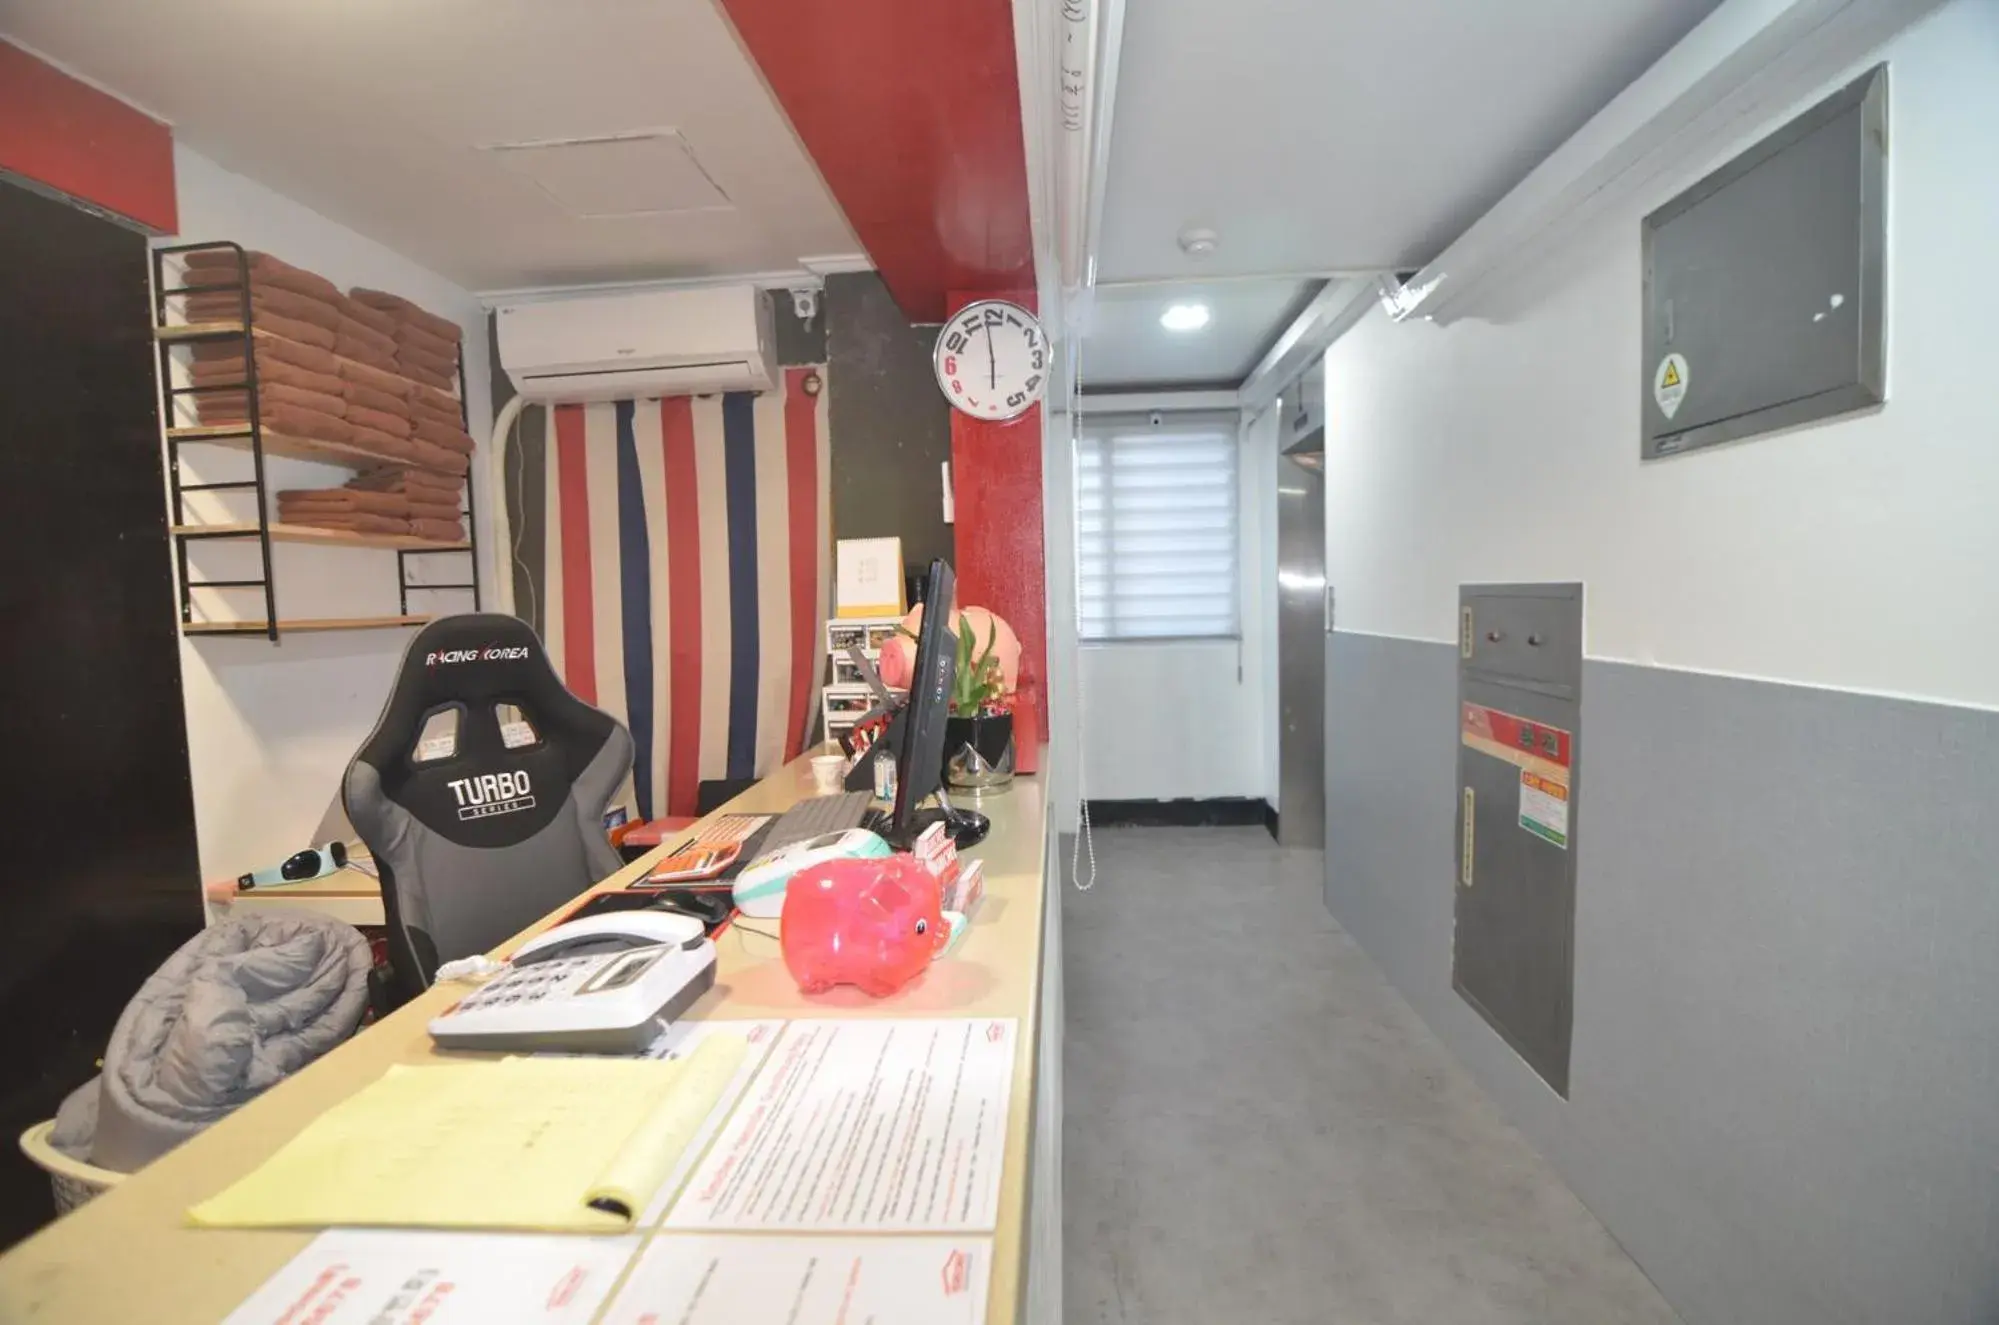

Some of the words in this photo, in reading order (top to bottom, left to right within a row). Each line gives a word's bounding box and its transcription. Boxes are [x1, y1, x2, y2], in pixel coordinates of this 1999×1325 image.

[961, 314, 983, 337] 11
[984, 308, 1004, 327] 12
[1006, 313, 1024, 329] 1
[945, 331, 969, 355] 10
[1023, 327, 1038, 348] 2
[1031, 349, 1043, 370] 3
[951, 379, 963, 395] 8
[1024, 374, 1042, 392] 4
[1006, 391, 1027, 408] 5
[425, 648, 479, 666] RACING
[447, 769, 532, 806] TURBO
[472, 802, 519, 816] SERIES
